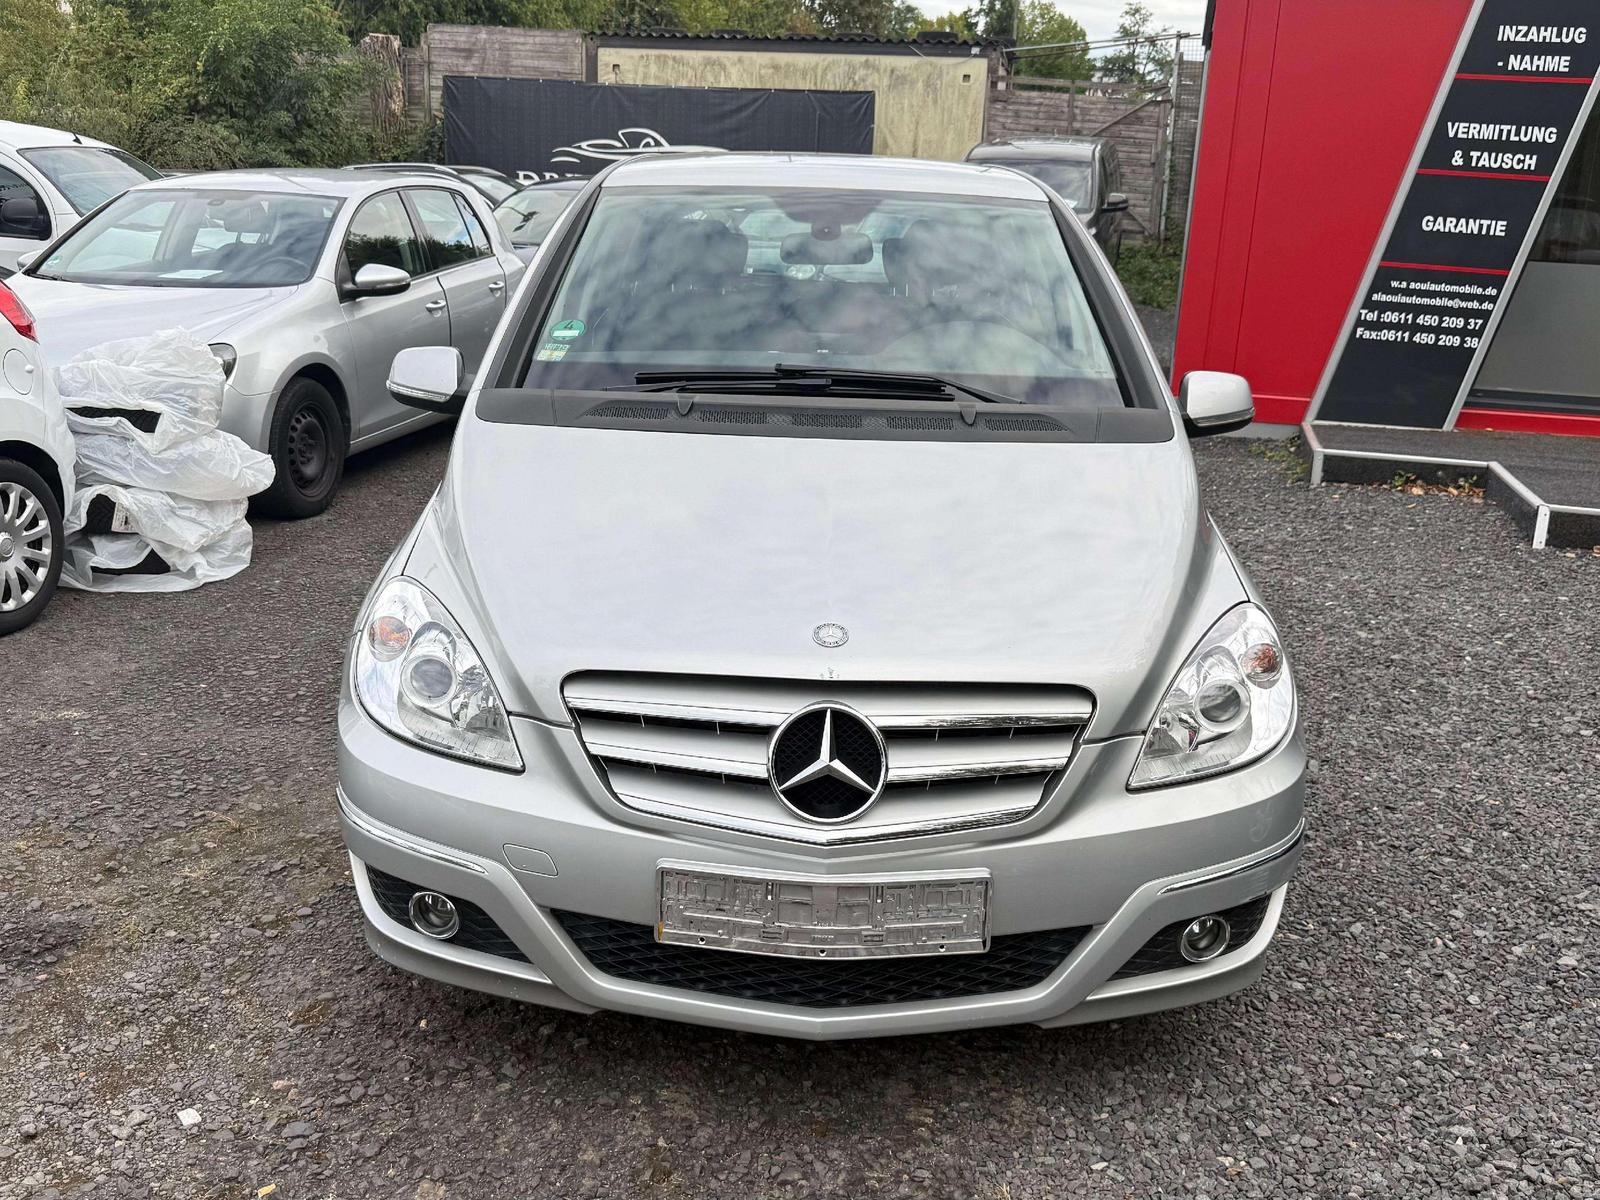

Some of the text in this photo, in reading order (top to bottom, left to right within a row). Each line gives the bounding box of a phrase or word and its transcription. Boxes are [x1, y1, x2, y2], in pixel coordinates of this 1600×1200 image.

[1497, 25, 1587, 44] INZAHLUG
[1507, 54, 1571, 72] NAHME
[1447, 122, 1558, 144] VERMITLUNG
[1451, 150, 1537, 170] & TAUSCH
[1421, 215, 1507, 237] GARANTIE
[1371, 292, 1494, 311] alaouiautomobile@web.de
[1359, 309, 1484, 331] Tel :0611 450 209 37
[1355, 327, 1480, 349] Fax:0611 450 209 38
